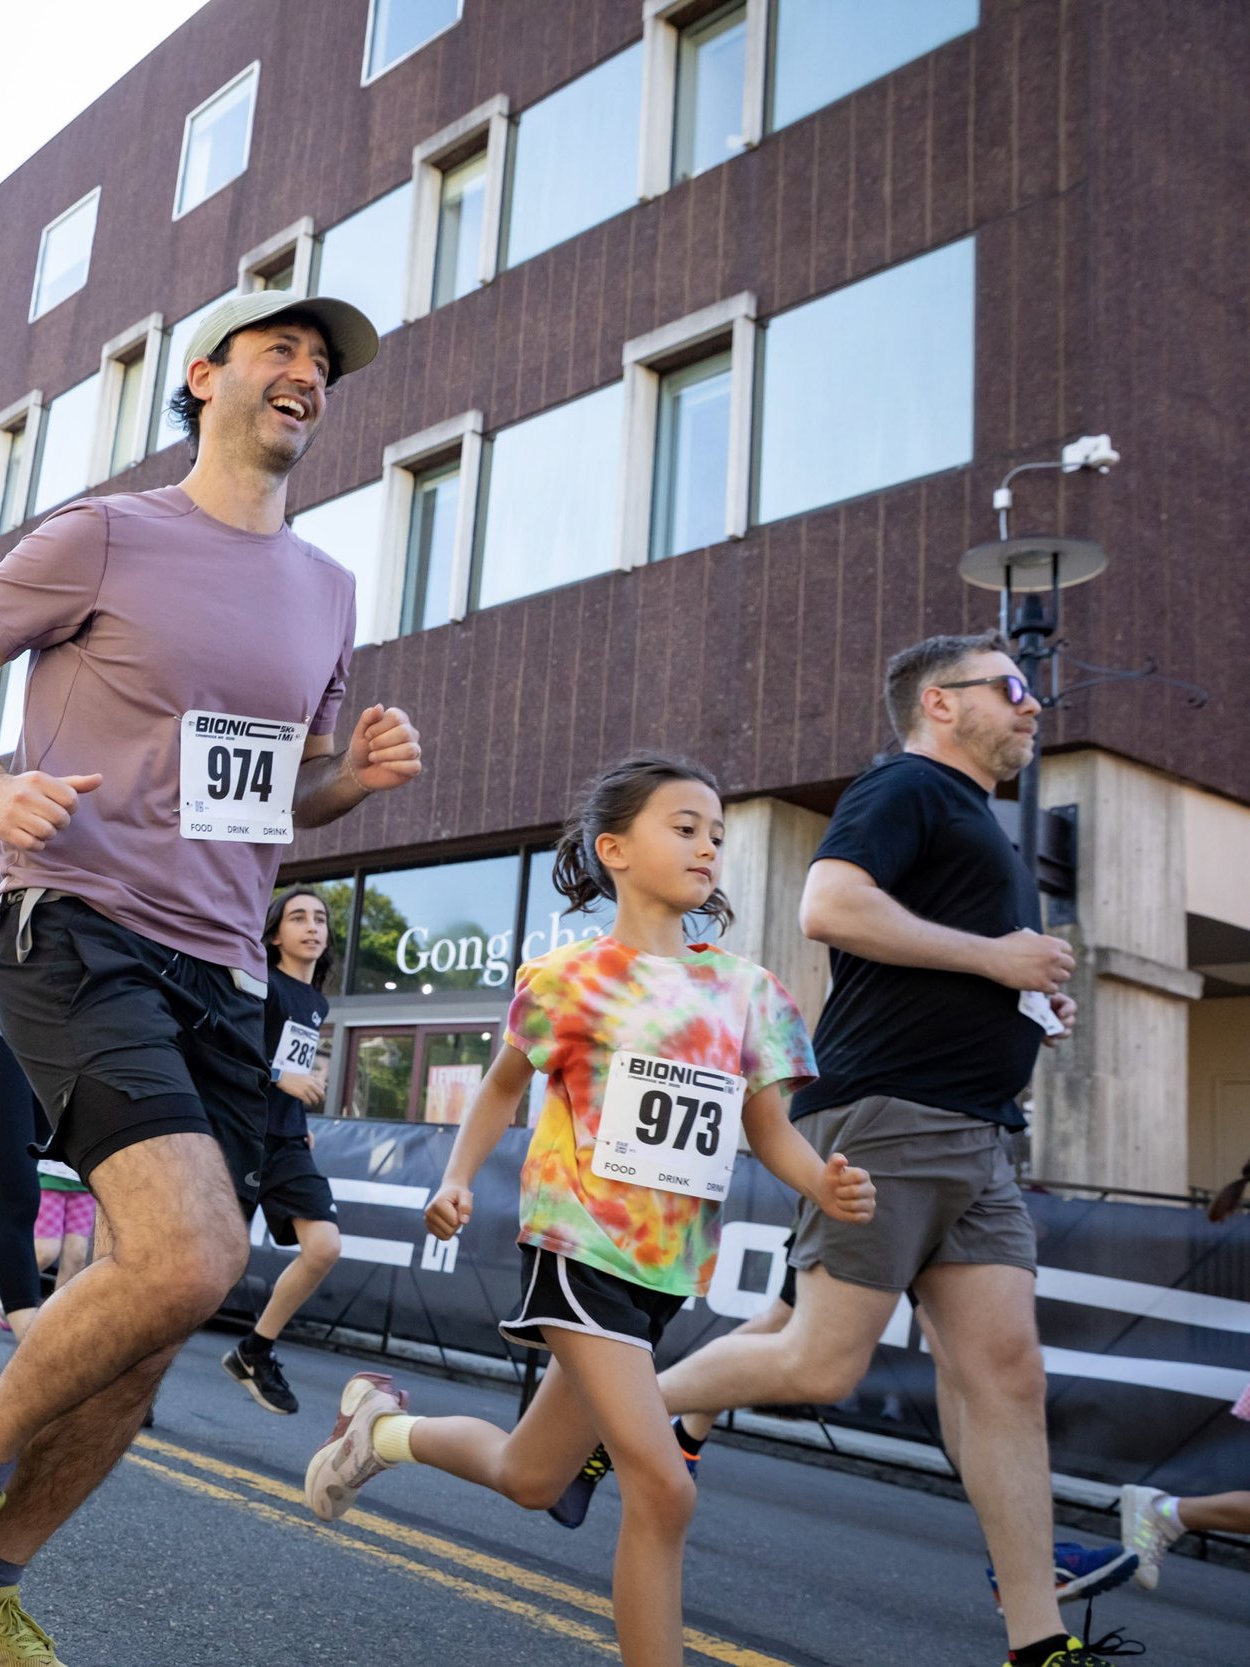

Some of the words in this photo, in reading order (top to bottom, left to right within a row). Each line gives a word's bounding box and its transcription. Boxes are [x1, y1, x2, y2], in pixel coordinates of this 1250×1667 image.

[195, 716, 281, 740] BIONIC
[207, 745, 274, 803] 974
[190, 823, 213, 833] FOOD
[227, 825, 250, 835] DRINK
[263, 827, 288, 836] DRINK
[396, 926, 512, 987] Gong
[629, 1058, 726, 1092] BIONIC
[635, 1090, 723, 1157] 973
[604, 1162, 637, 1176] FOOD
[658, 1173, 690, 1187] DRINK
[706, 1182, 725, 1193] DRINK
